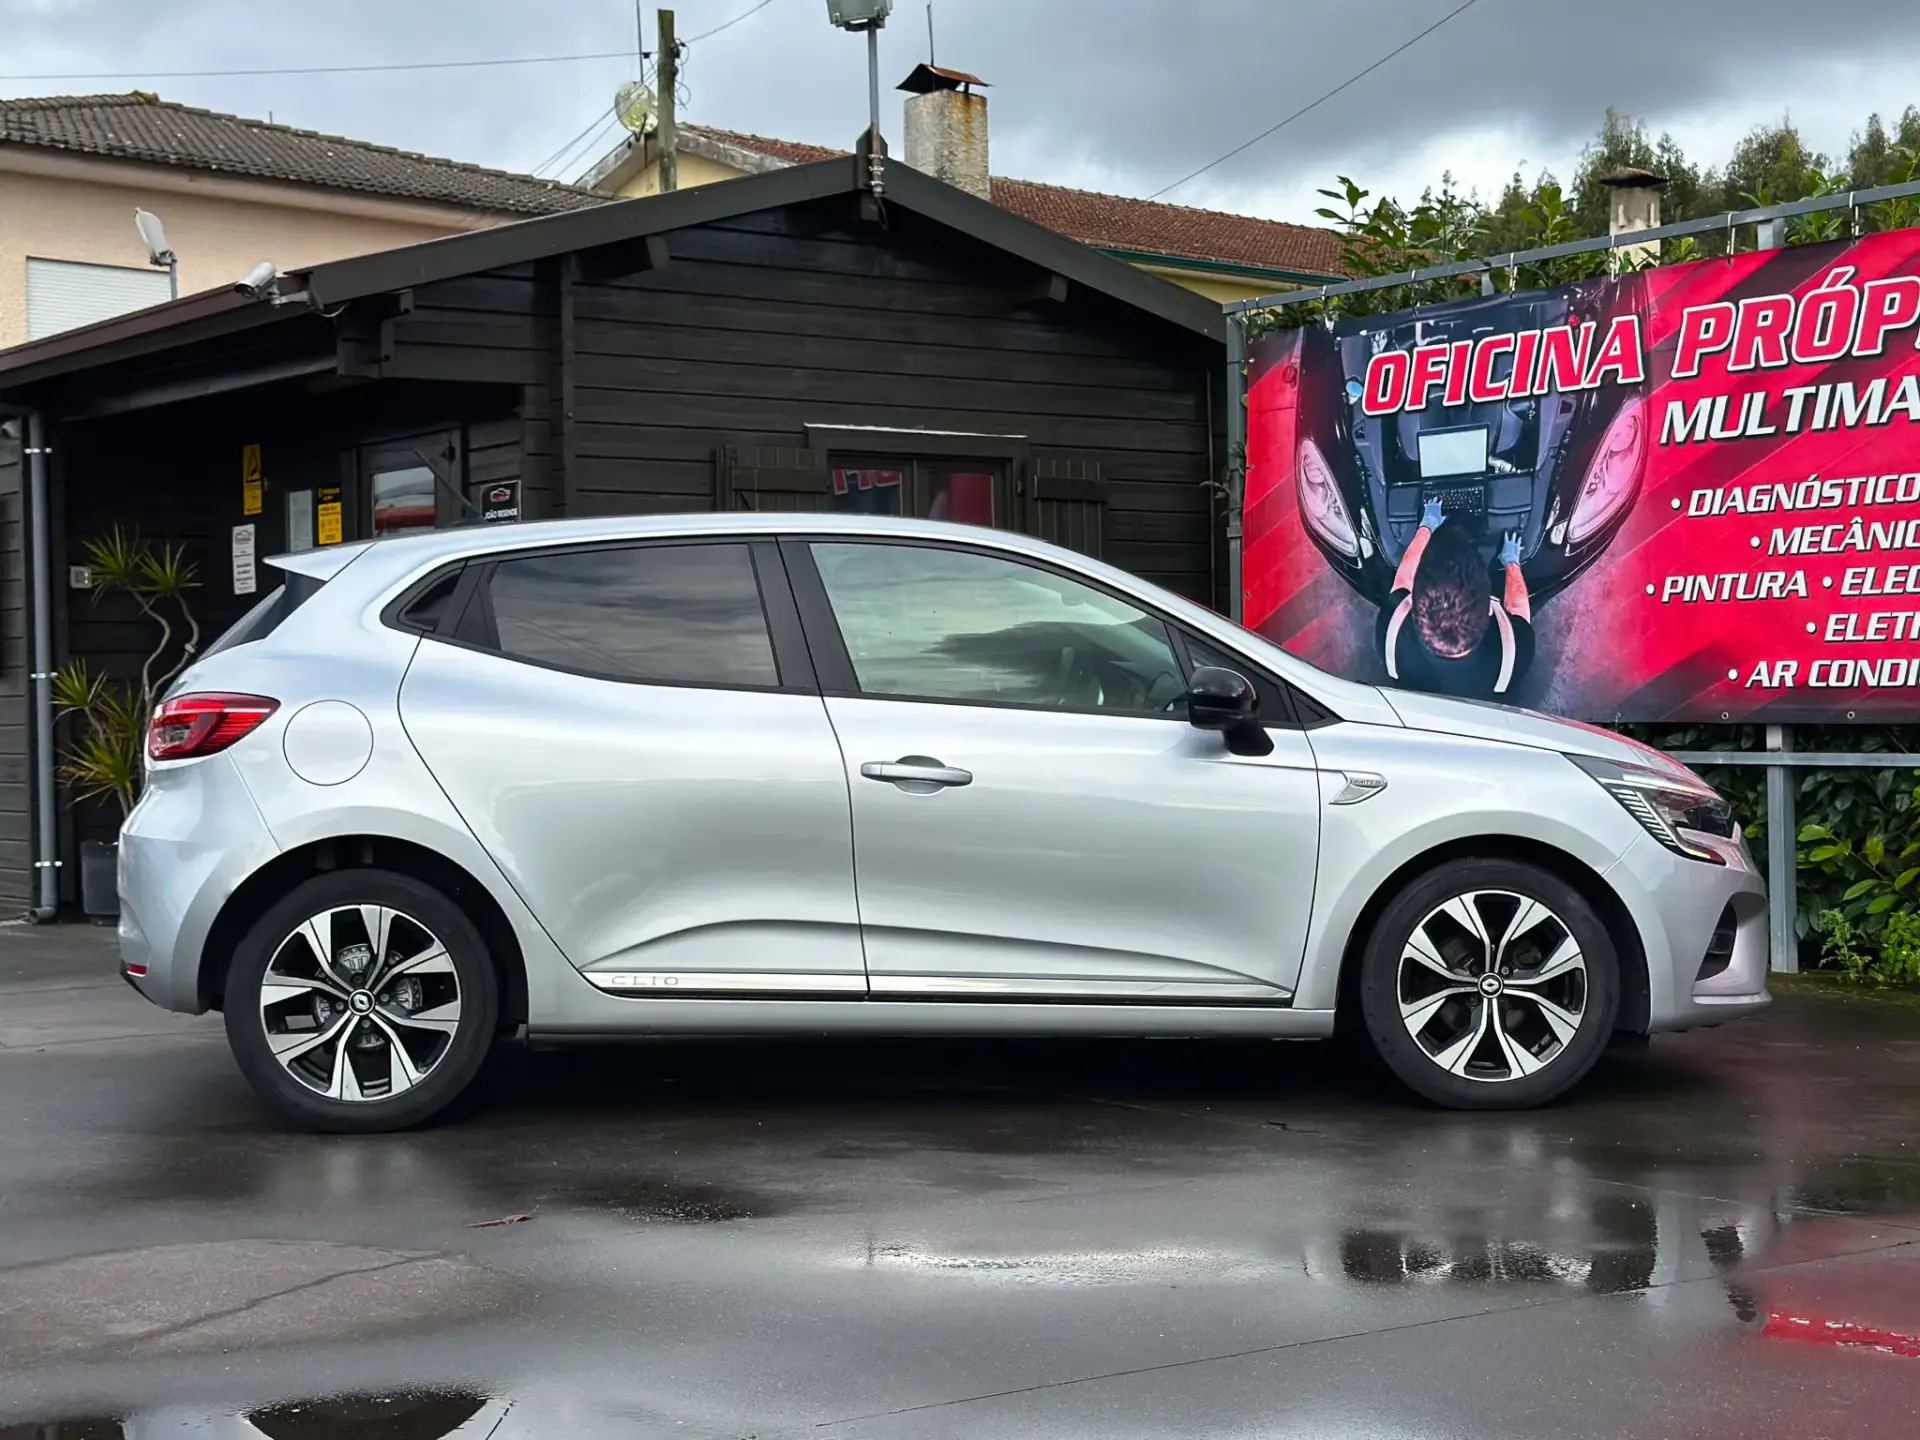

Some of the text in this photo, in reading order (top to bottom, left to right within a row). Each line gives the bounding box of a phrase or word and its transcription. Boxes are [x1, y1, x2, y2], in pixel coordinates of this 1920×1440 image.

[1362, 265, 1920, 416] OFICINA PRÓP
[1660, 375, 1920, 444] MULTIMA
[1687, 473, 1920, 517] DIAGNÓSTICO
[1767, 516, 1920, 556] MECÂNIC
[1661, 565, 1920, 603] PINTURA ELEC
[1745, 658, 1920, 688] AR CONDI
[611, 976, 679, 986] CLIO
